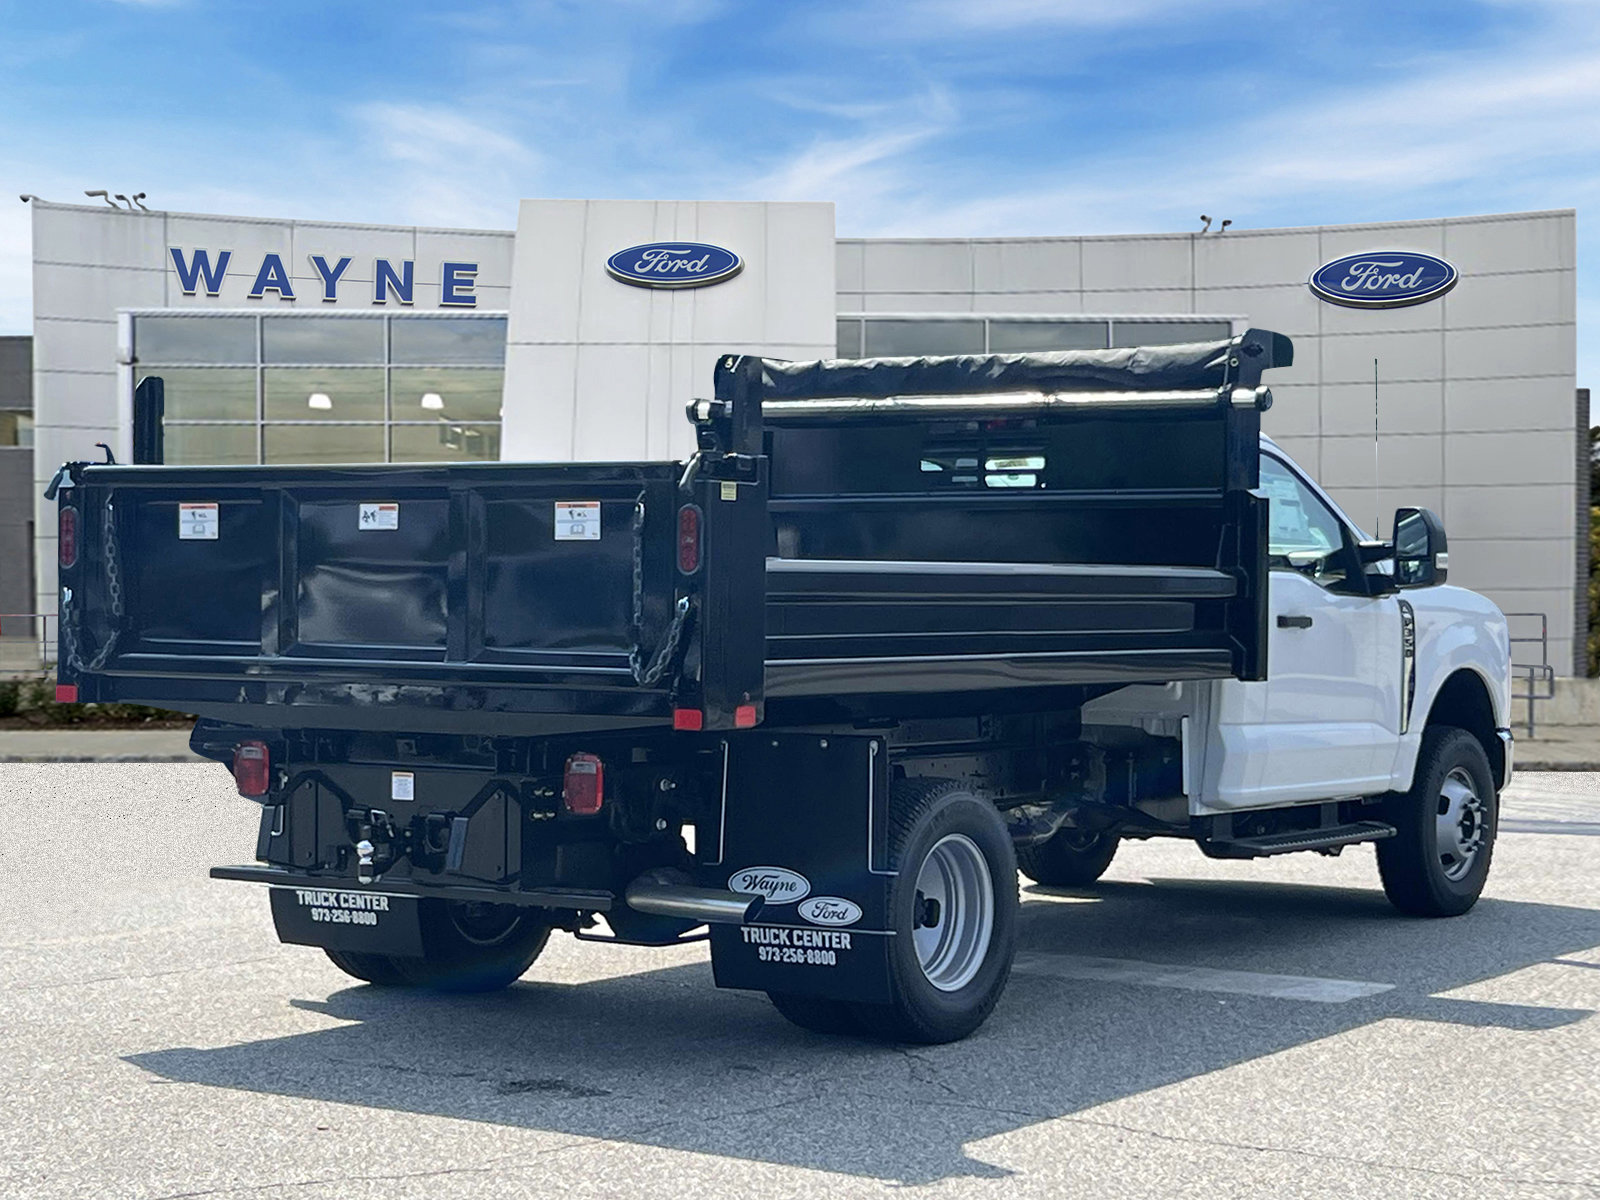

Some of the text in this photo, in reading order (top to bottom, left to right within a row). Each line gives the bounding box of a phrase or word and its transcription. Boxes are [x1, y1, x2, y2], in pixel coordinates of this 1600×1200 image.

[633, 248, 710, 274] Ford
[168, 246, 480, 308] WAYNE
[1341, 260, 1425, 292] Ford
[741, 873, 798, 899] Wayne
[295, 889, 390, 912] TRUCK CENTER
[811, 901, 849, 921] Ford
[740, 926, 852, 950] TRUCK CENTER
[758, 946, 837, 966] 973-256-8800
